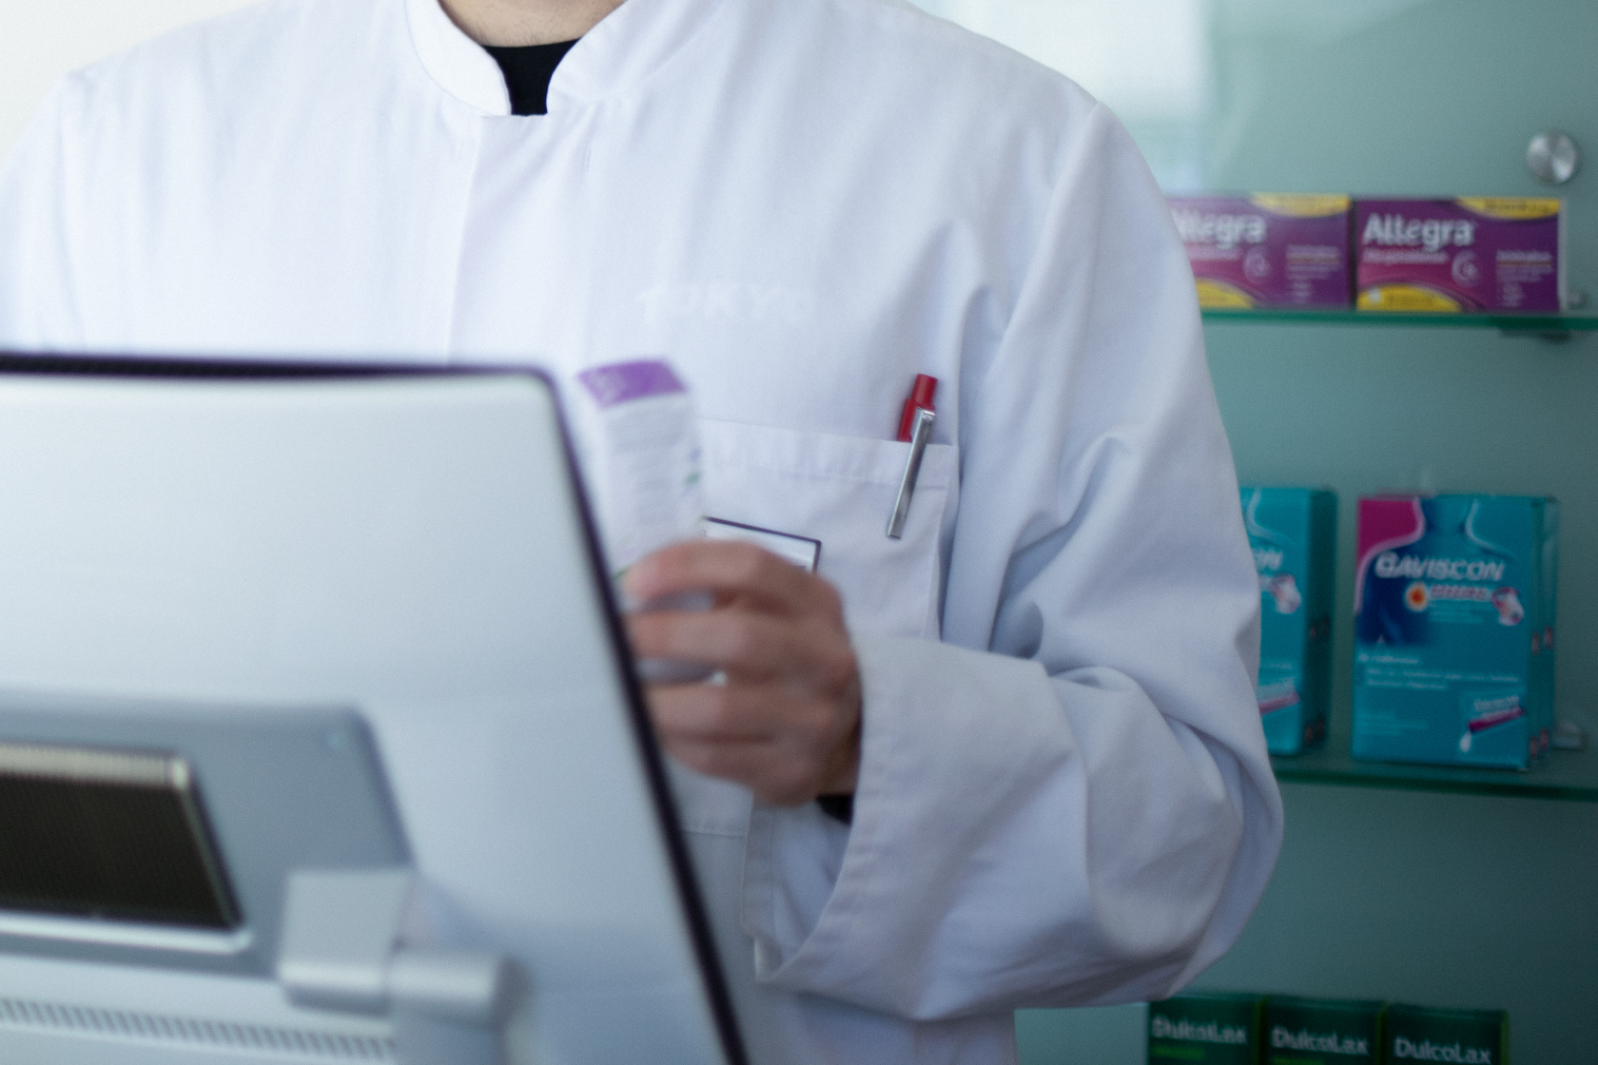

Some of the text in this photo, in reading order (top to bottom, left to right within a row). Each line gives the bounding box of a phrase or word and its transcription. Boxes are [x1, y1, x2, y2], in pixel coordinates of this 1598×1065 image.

[1173, 210, 1265, 250] llegra
[1362, 213, 1475, 252] Allegra
[1375, 551, 1505, 581] GAVISCON
[1272, 1026, 1369, 1056] DulcoLax
[1395, 1037, 1492, 1065] DulcoLax
